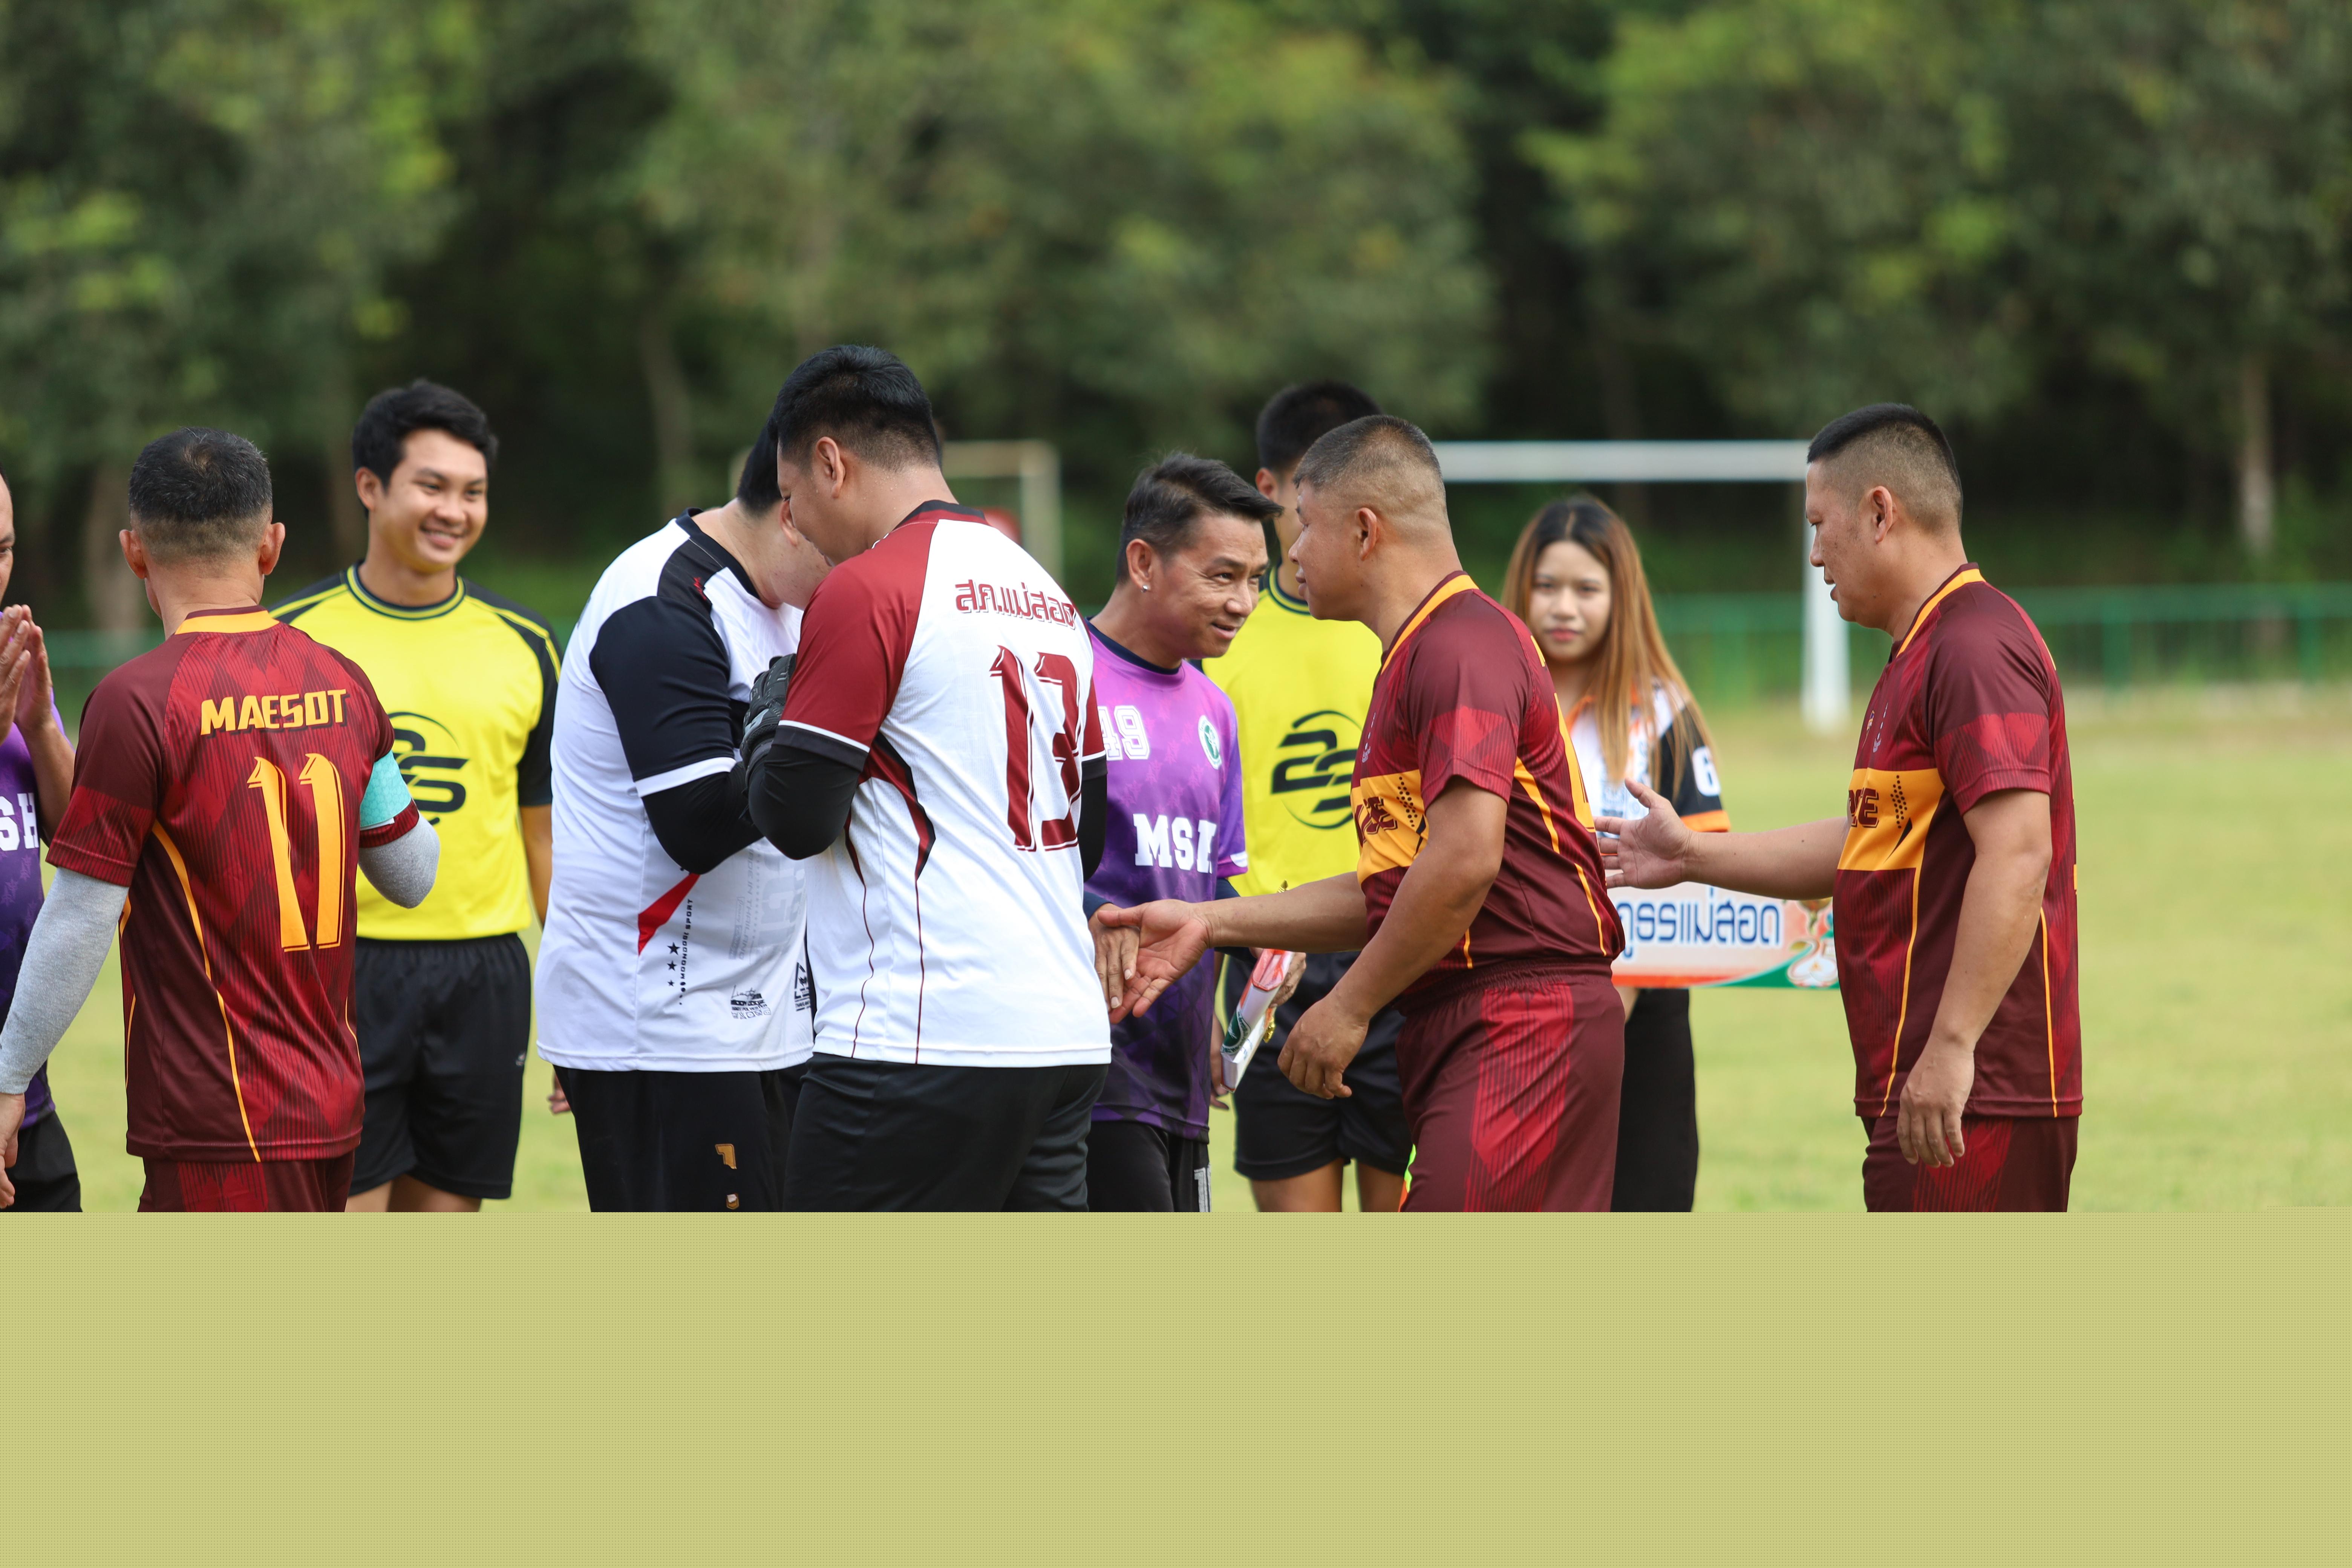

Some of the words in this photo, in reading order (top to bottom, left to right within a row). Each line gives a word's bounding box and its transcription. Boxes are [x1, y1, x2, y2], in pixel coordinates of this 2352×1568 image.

[201, 689, 351, 736] MAESOT
[989, 645, 1080, 852] 13
[247, 753, 345, 953] 11
